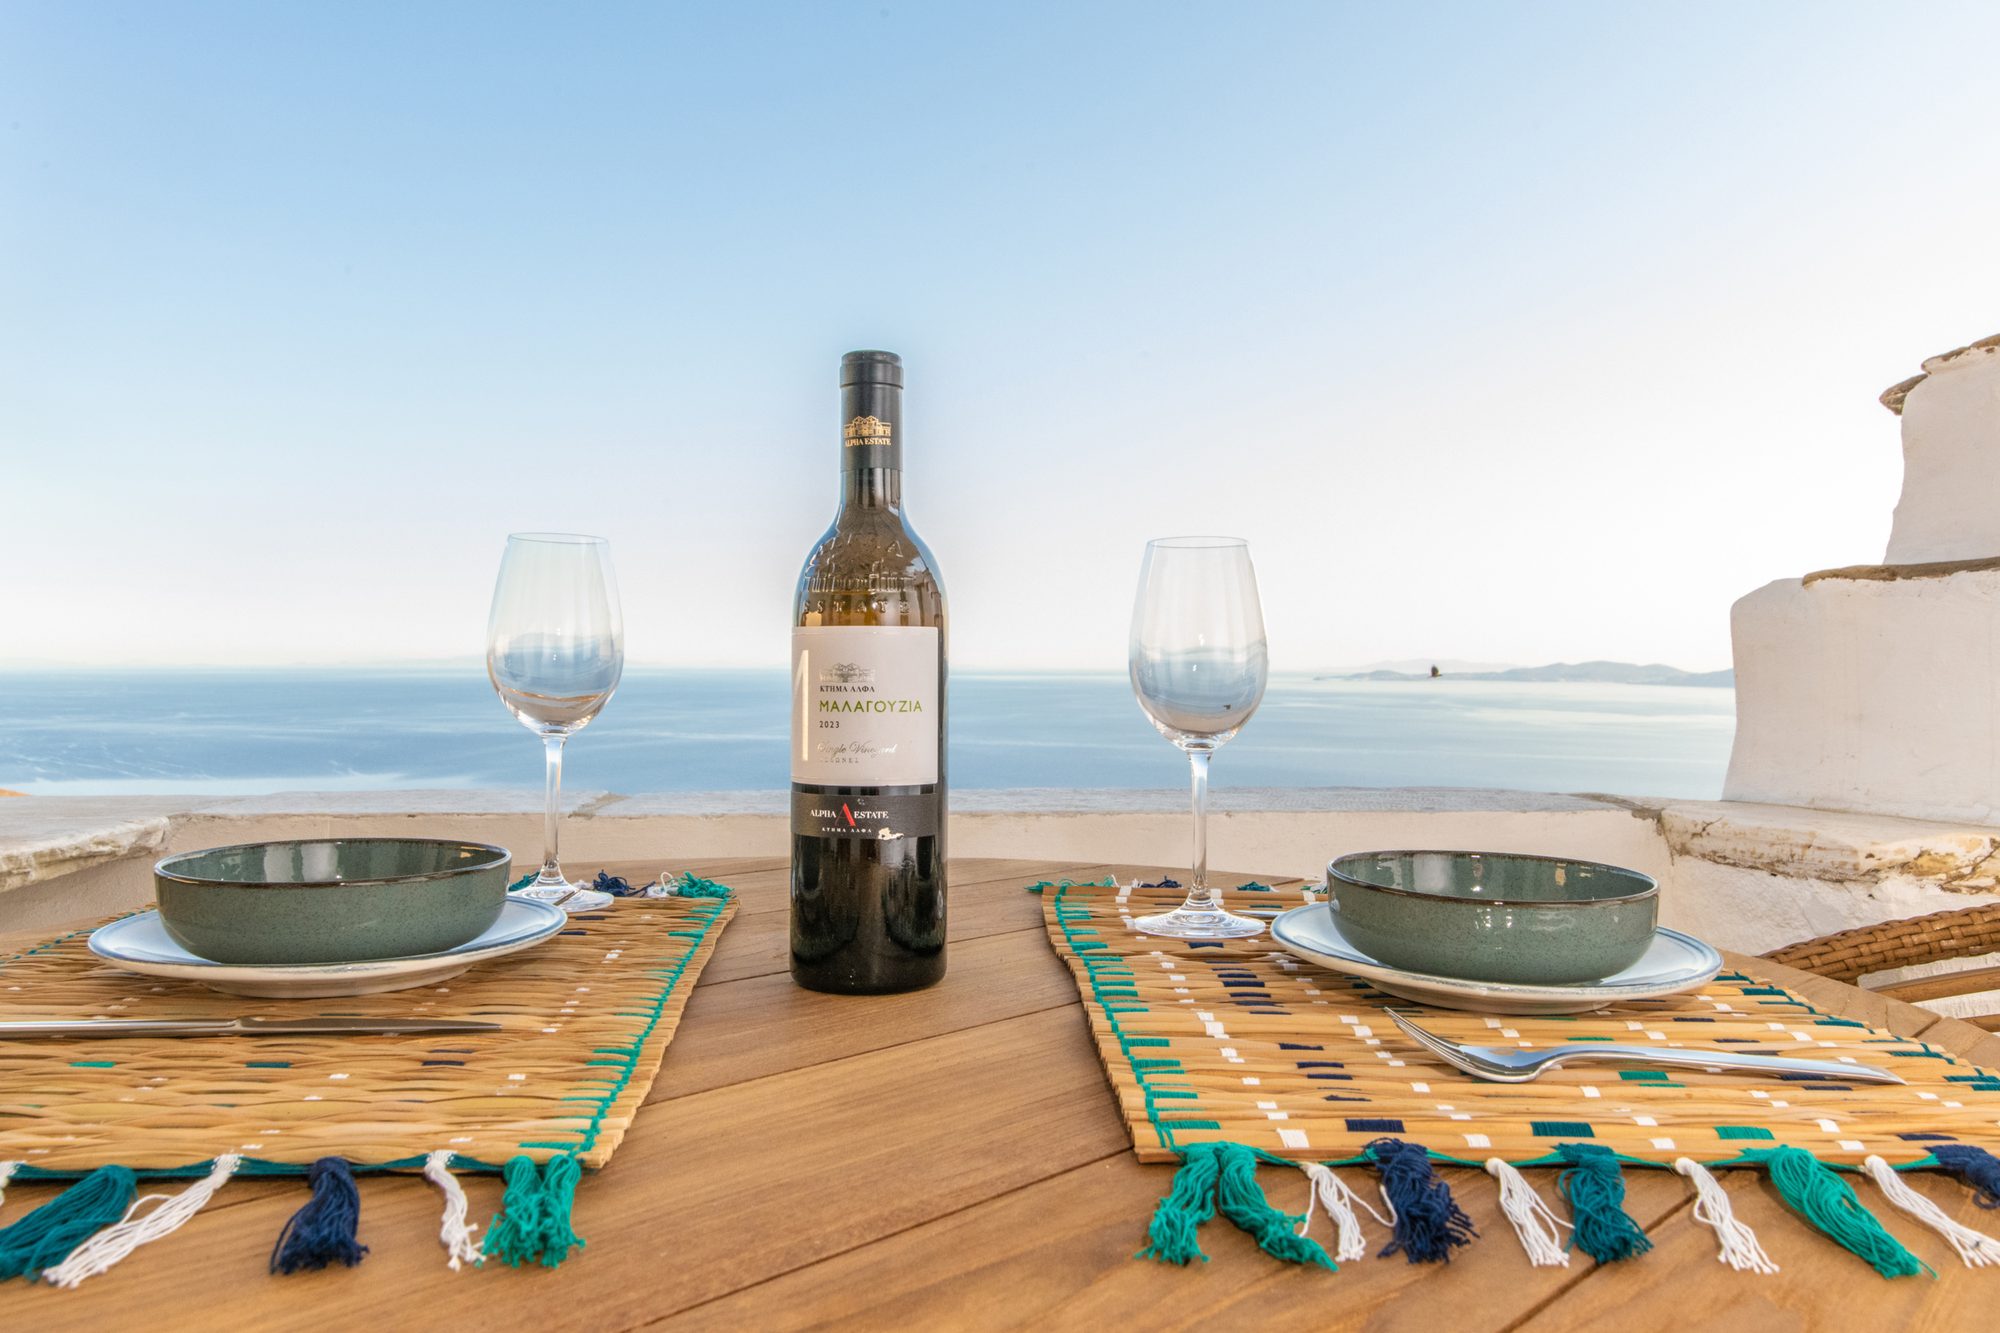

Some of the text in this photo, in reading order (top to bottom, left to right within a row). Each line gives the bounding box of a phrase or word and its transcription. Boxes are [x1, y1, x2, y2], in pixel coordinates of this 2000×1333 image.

[844, 437, 891, 447] ALPHA ESTATE
[819, 700, 922, 713] ΜΑΛΑΓΟΥΖΙΑ
[819, 721, 840, 729] 2023
[810, 809, 837, 818] ALPHA
[854, 810, 889, 819] ESTATE
